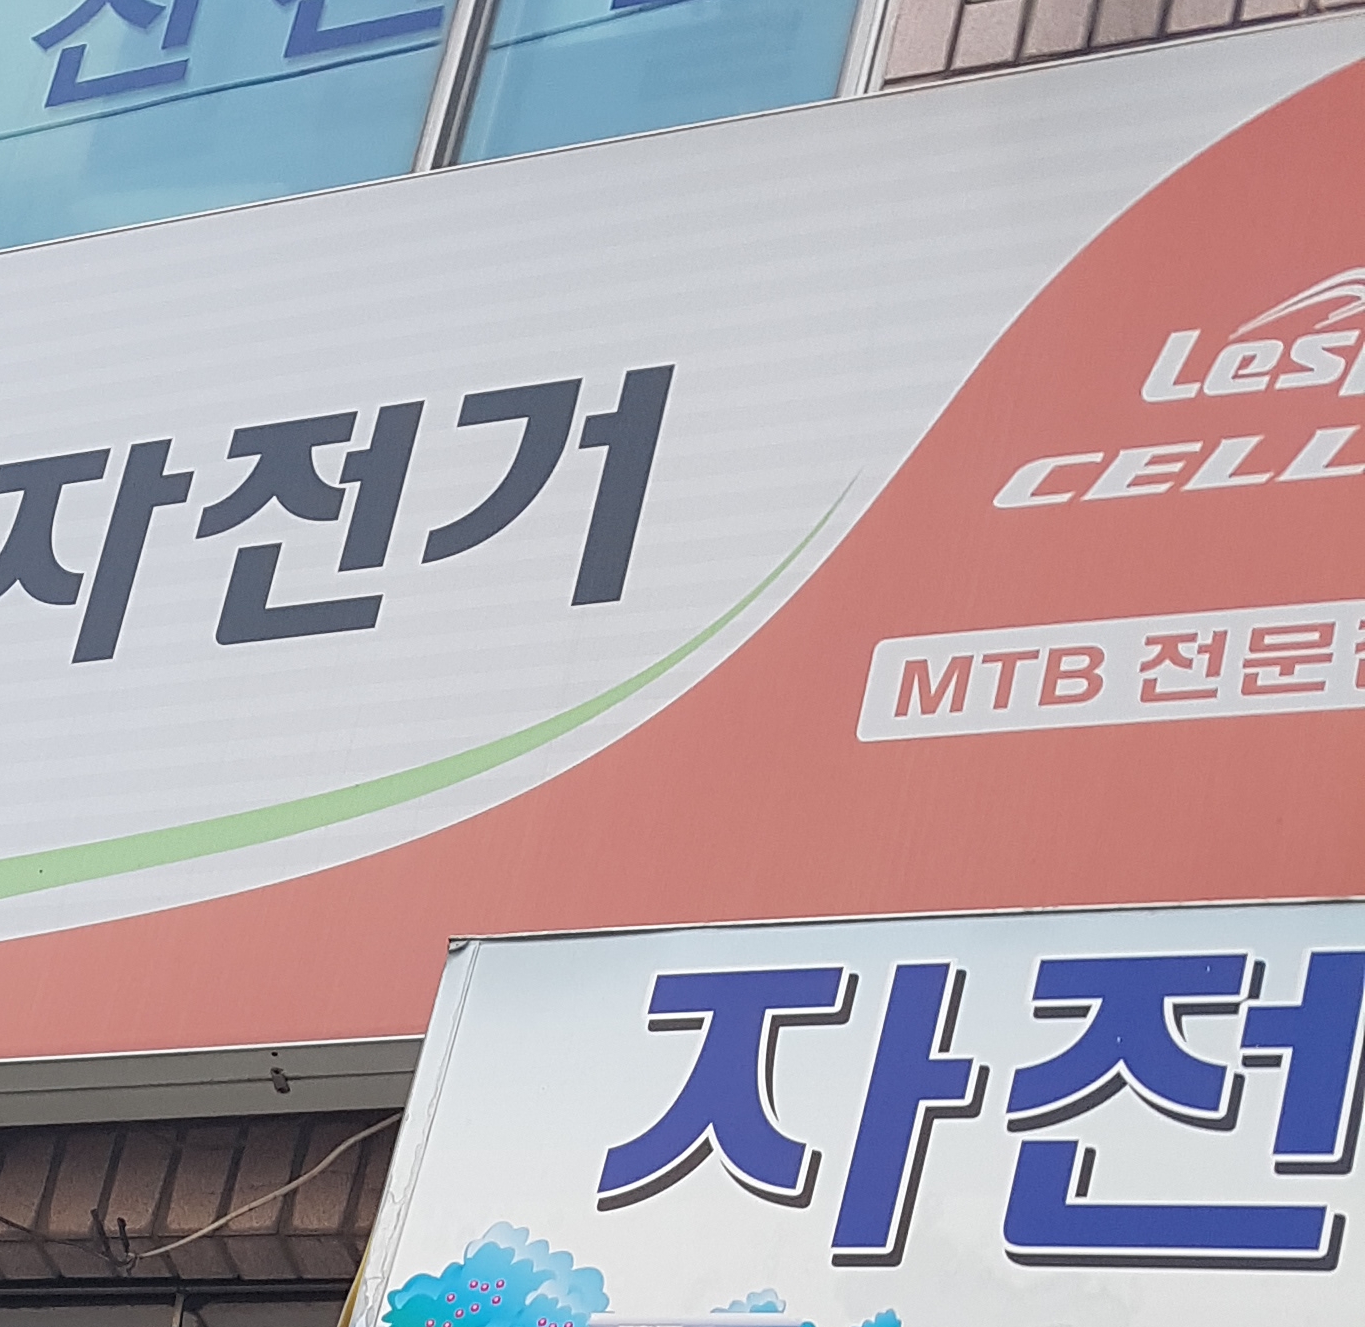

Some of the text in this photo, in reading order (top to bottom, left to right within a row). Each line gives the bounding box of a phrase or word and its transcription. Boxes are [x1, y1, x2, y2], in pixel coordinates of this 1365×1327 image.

[1141, 328, 1365, 403] Les
[893, 617, 1365, 718] MTB 전문
